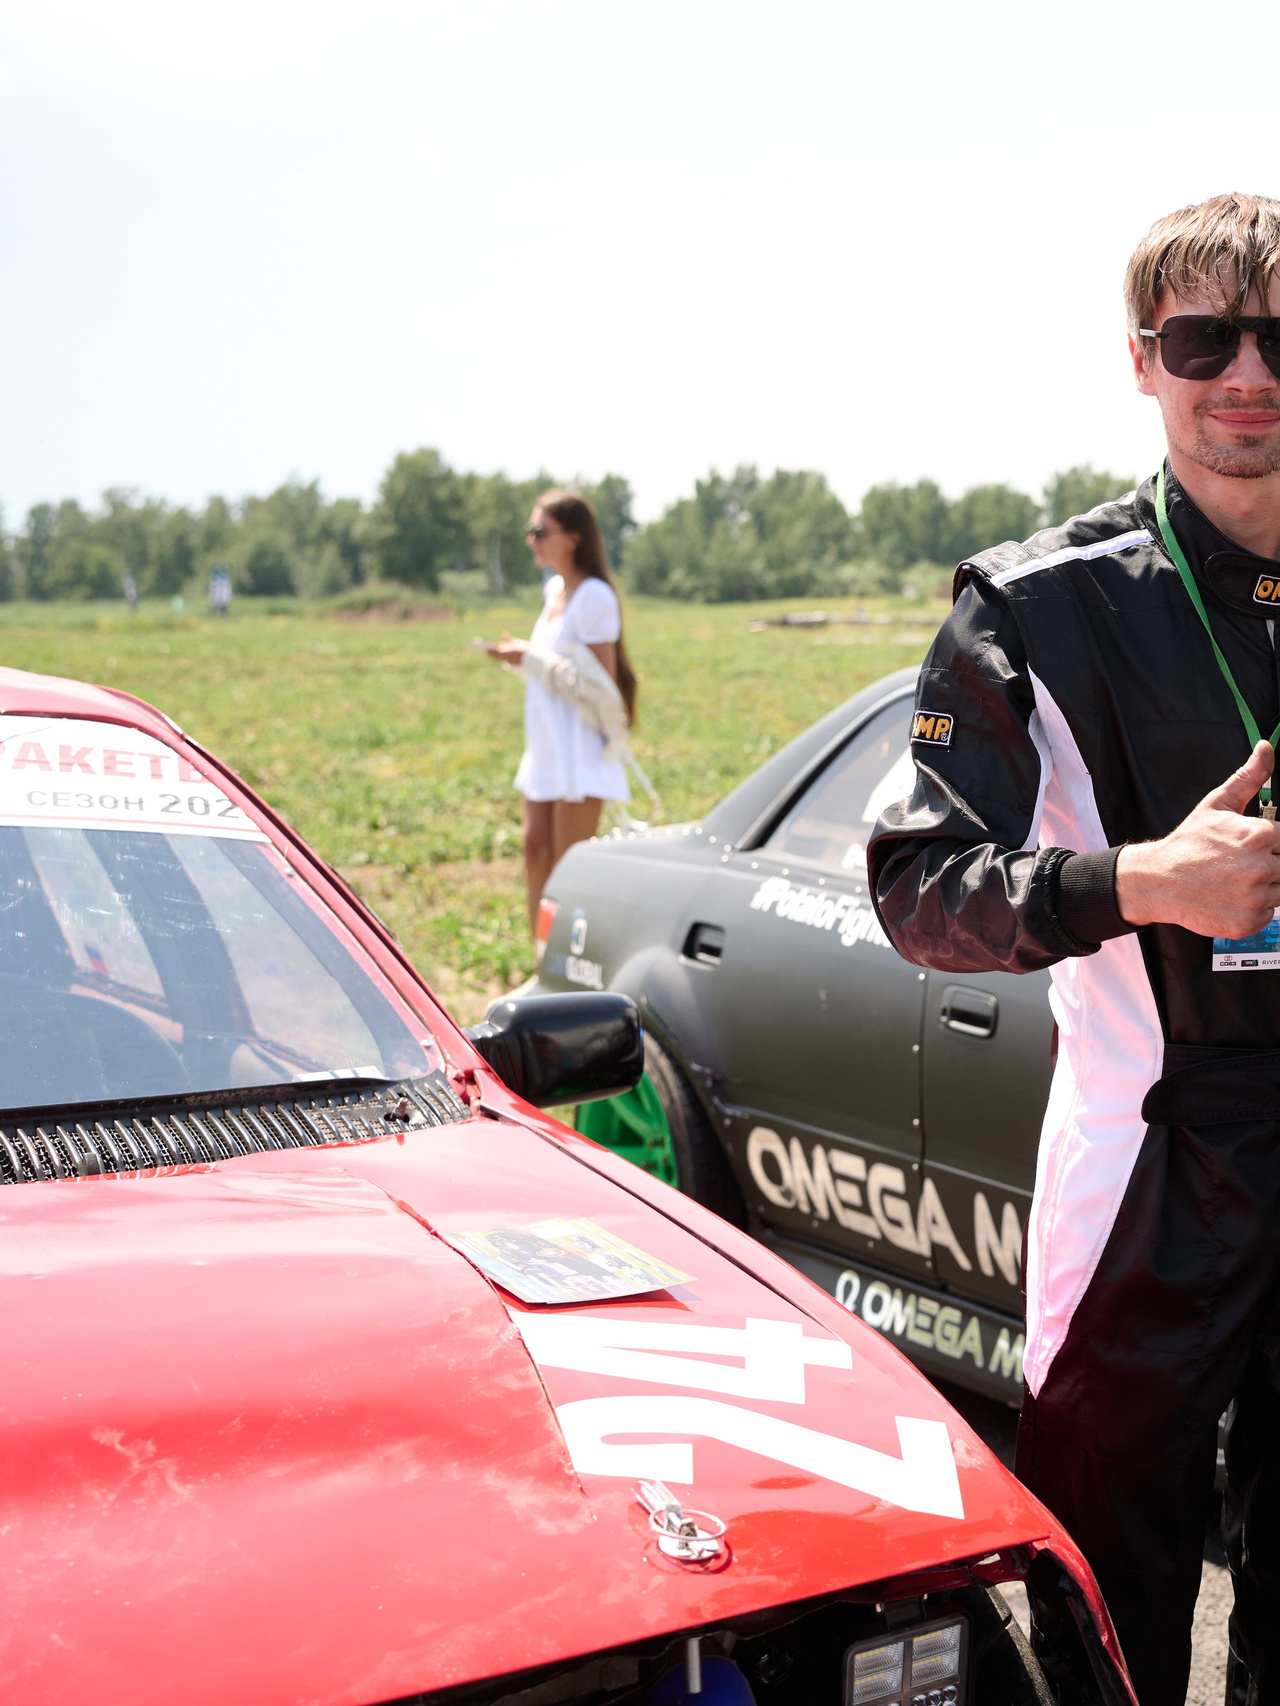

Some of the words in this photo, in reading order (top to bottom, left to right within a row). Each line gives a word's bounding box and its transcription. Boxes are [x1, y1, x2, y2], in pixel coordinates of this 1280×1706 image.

[912, 714, 951, 740] MP
[27, 790, 144, 812] СЕЗОН
[747, 1126, 972, 1272] OMEGA
[862, 1281, 983, 1368] OMEGA
[511, 1311, 965, 1520] 24
